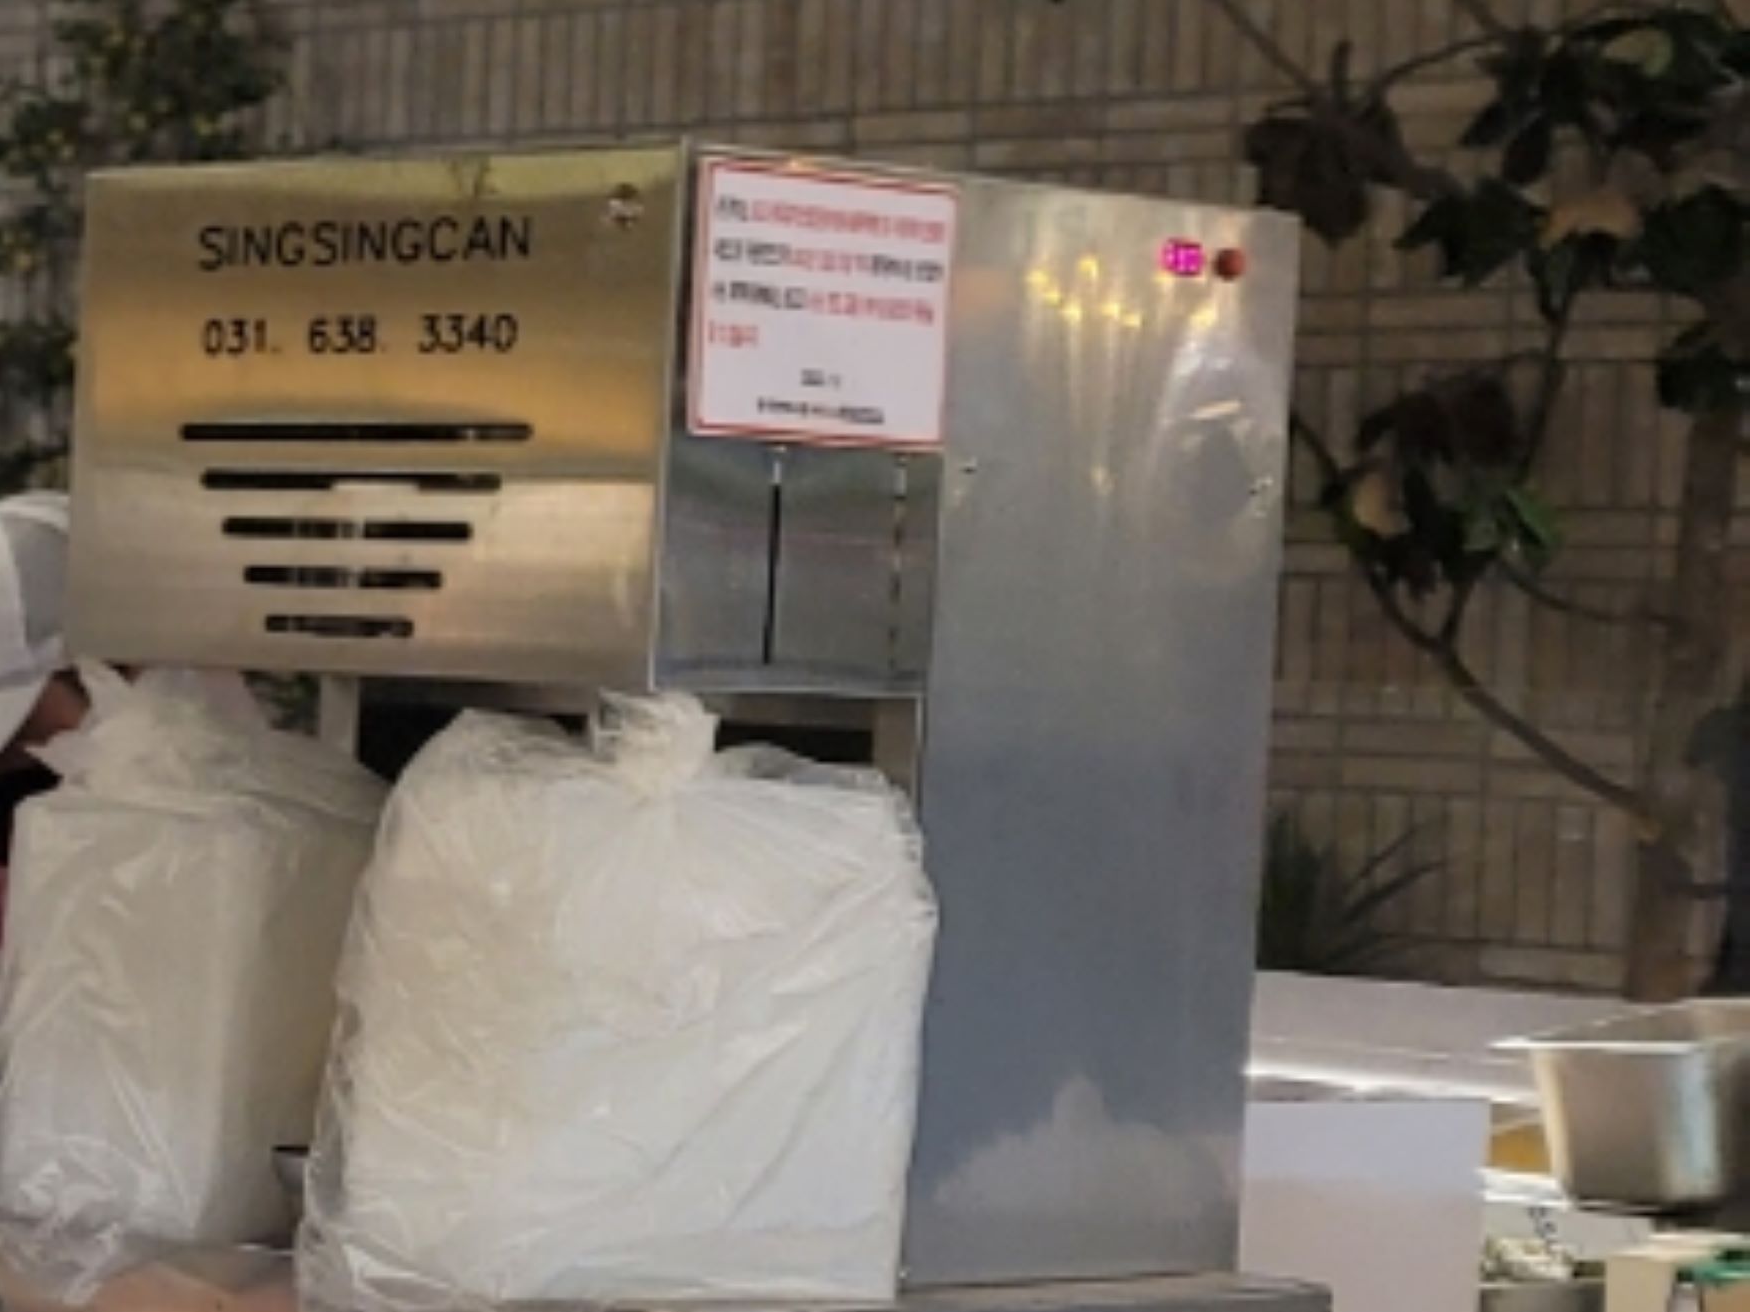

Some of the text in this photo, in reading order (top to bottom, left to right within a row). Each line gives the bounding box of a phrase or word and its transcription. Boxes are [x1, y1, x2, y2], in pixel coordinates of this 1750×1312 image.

[198, 216, 533, 273] SINGSINGCAN
[202, 312, 519, 357] 031. 638. 3340
